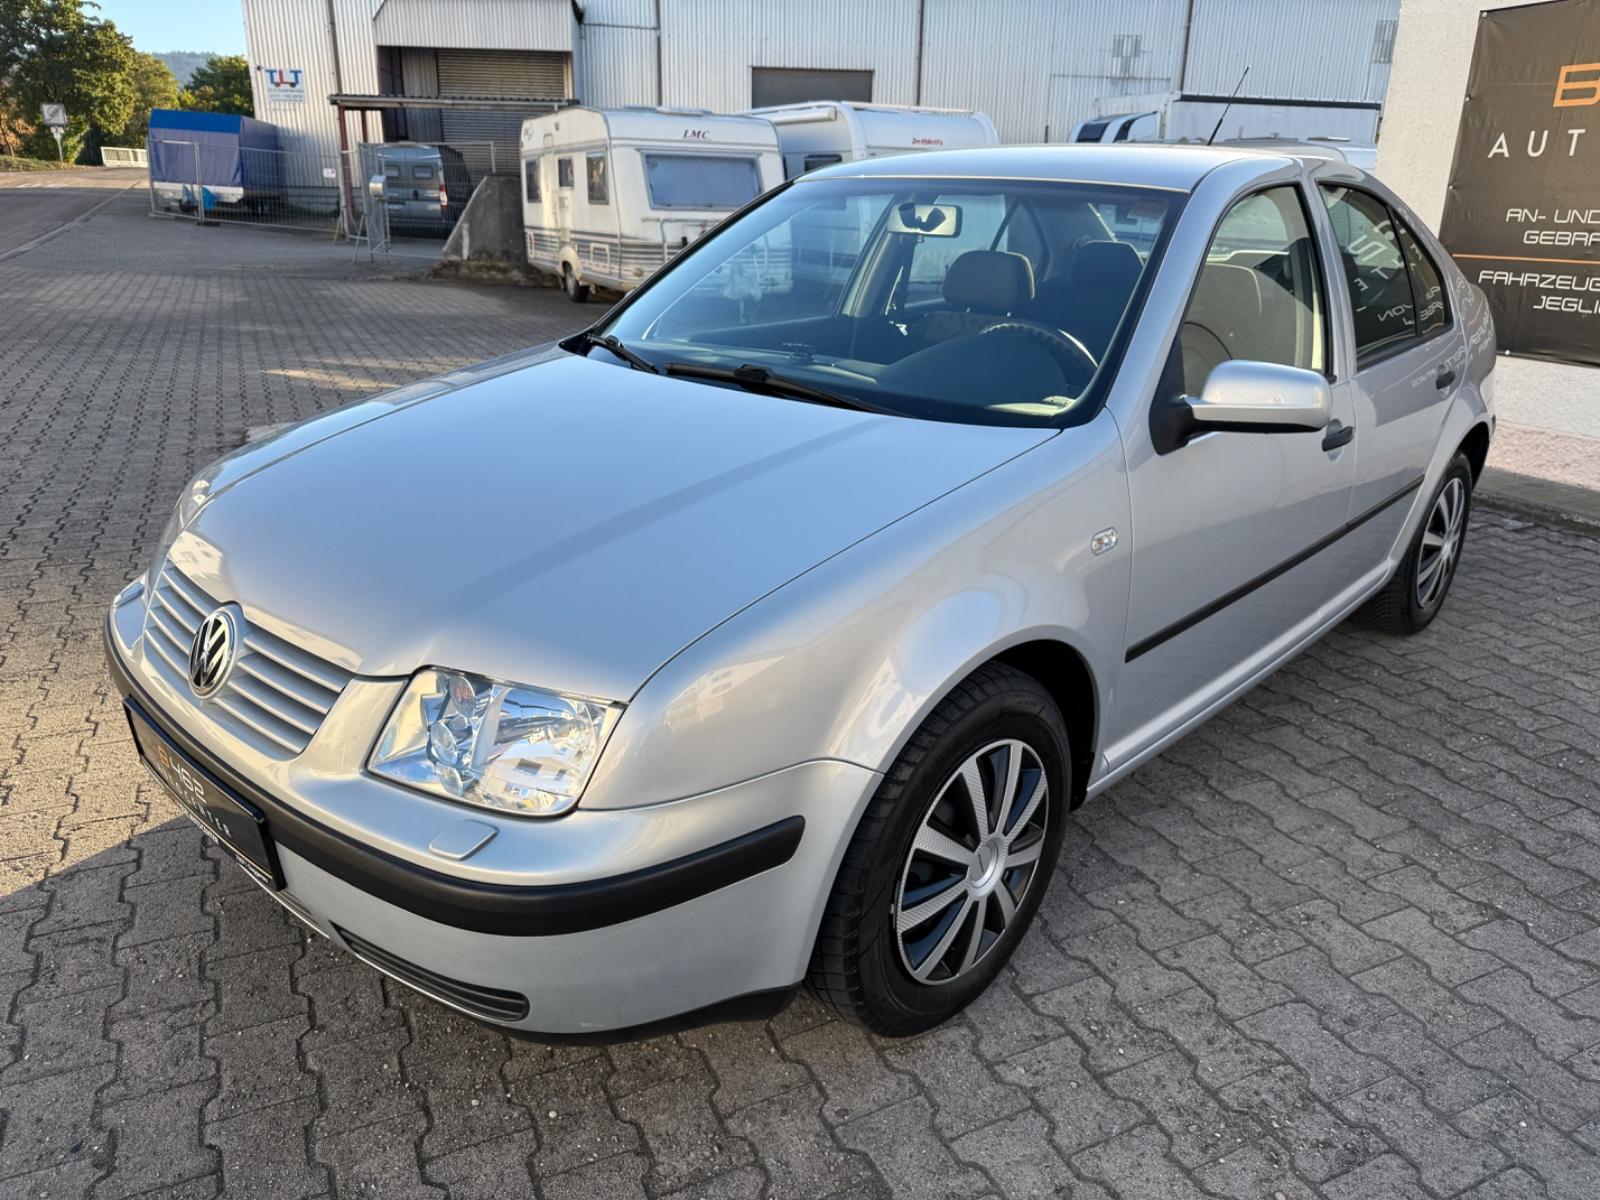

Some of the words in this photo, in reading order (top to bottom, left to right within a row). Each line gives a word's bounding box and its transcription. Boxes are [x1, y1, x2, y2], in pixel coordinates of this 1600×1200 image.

[683, 129, 710, 139] LMC
[1506, 208, 1546, 222] AN-
[1533, 295, 1600, 314] JEGLI
